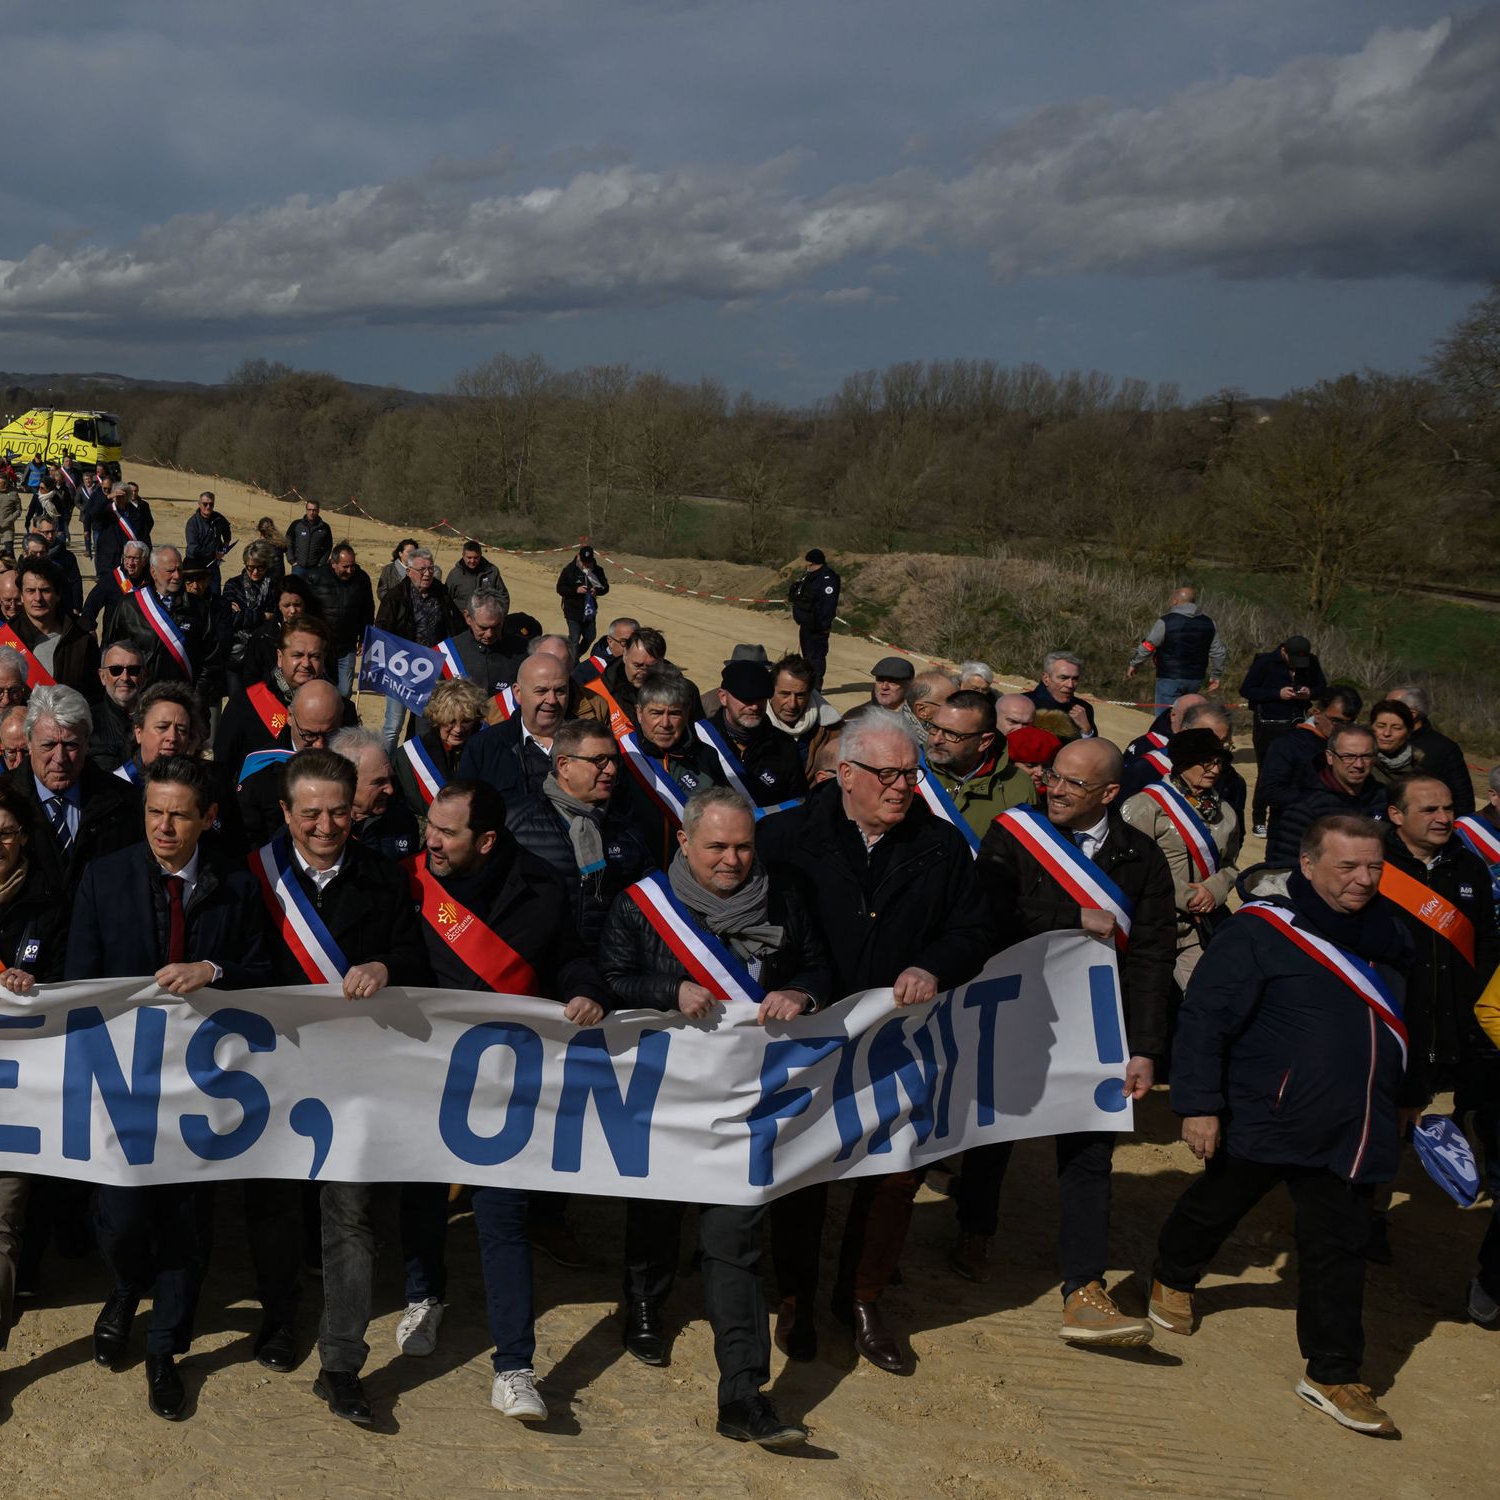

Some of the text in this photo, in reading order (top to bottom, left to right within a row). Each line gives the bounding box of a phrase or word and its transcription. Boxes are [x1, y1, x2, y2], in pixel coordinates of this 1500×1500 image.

[1, 441, 89, 457] AUTOMOBILES
[364, 639, 434, 684] A69
[381, 673, 416, 701] FINIT
[683, 774, 697, 787] A69
[761, 772, 775, 784] A69
[1418, 896, 1440, 918] TARN
[447, 914, 472, 941] Occitanie
[25, 945, 38, 954] 69
[438, 1021, 671, 1178] ON
[745, 974, 1022, 1187] FINIT
[1088, 965, 1127, 1113] !
